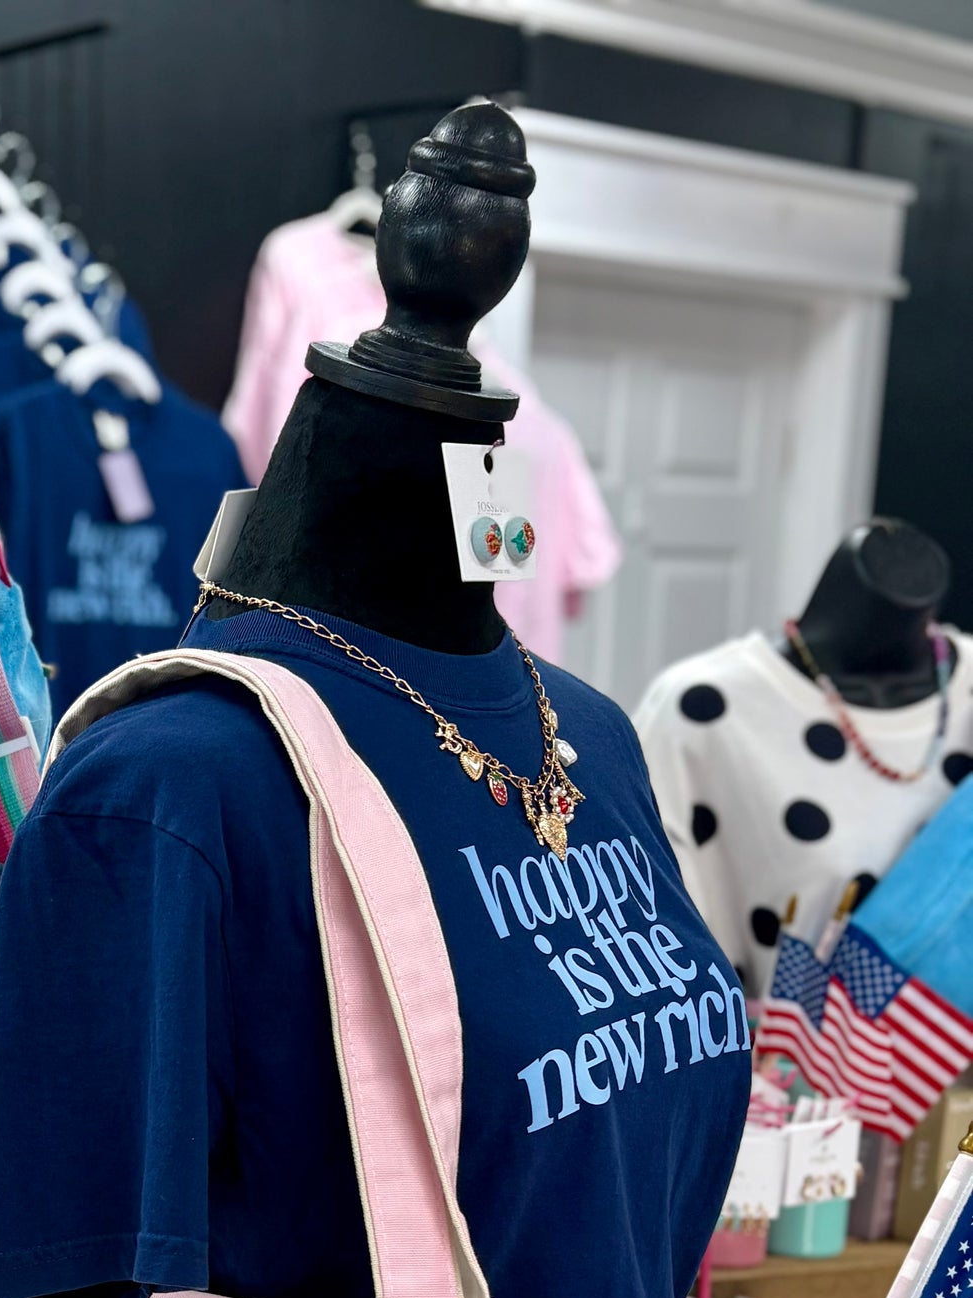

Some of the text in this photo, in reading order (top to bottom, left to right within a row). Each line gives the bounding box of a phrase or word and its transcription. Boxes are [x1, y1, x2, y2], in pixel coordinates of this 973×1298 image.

[458, 835, 658, 939] happy
[533, 908, 697, 1016] is the
[517, 962, 752, 1134] new rich
